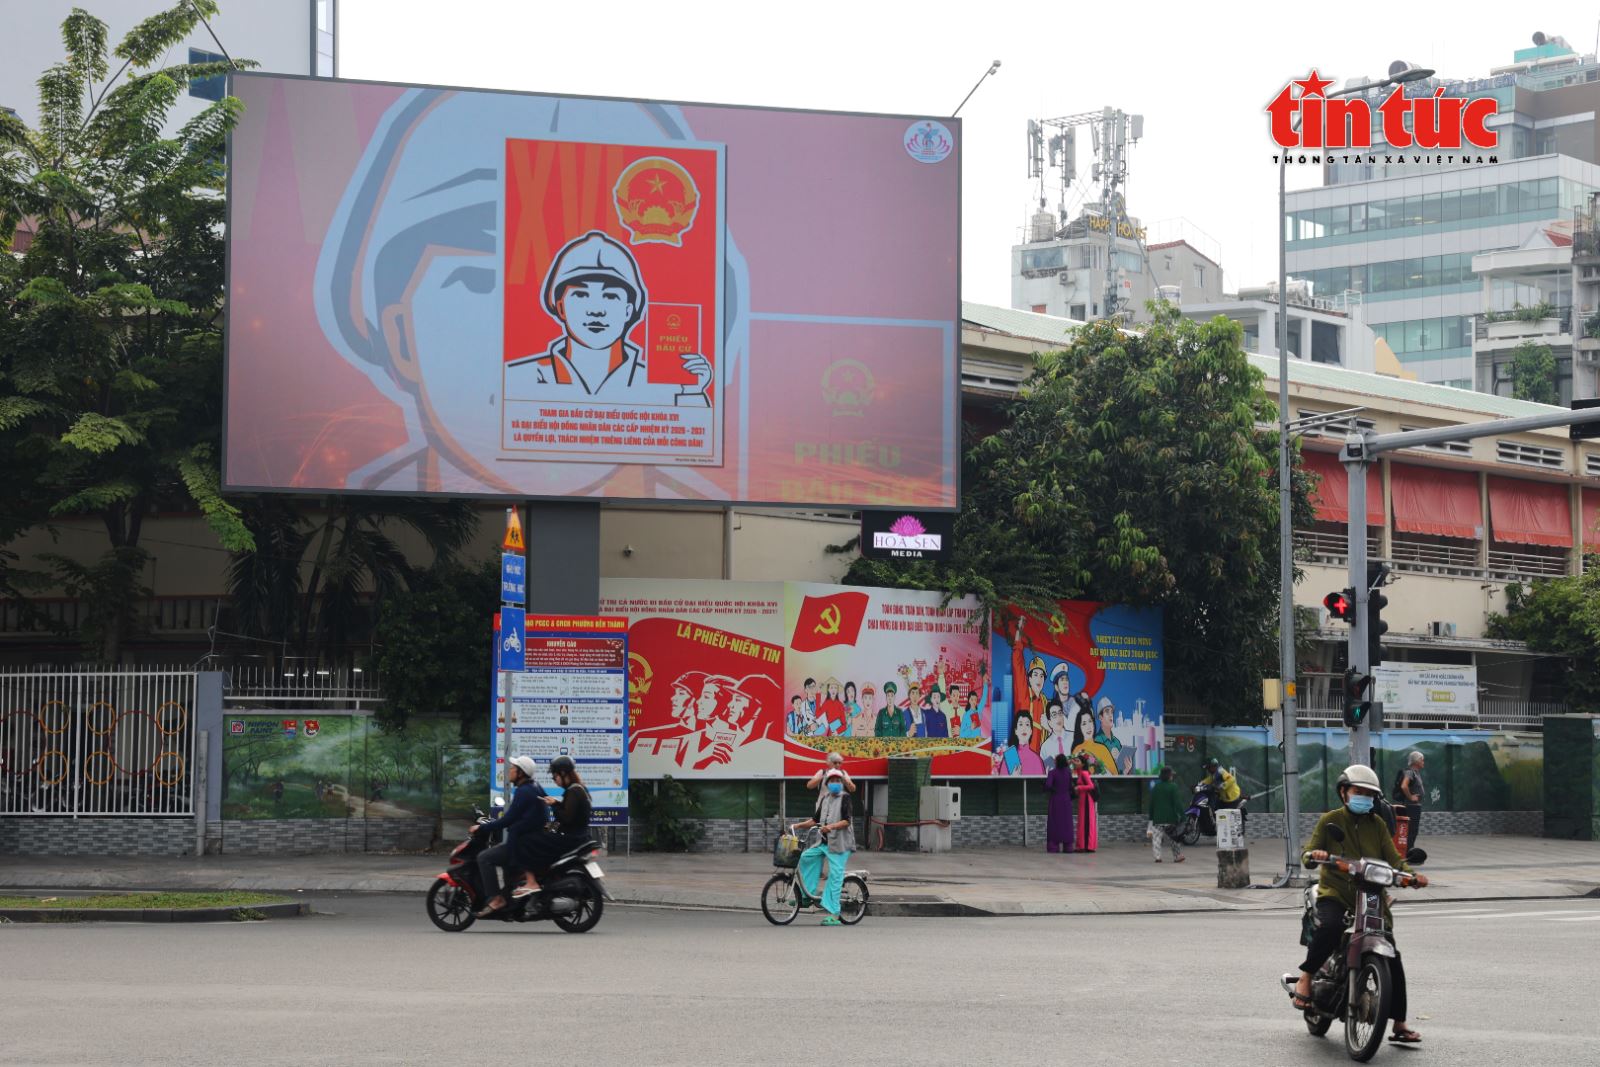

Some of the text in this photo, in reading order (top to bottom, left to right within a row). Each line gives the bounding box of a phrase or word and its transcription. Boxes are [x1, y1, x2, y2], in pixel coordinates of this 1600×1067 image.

[540, 408, 558, 417] THAM
[559, 410, 569, 418] GIA
[622, 410, 638, 420] QUỐC
[640, 411, 650, 422] HỘI
[612, 423, 624, 432] CÁC
[876, 535, 940, 549] HOA SEN
[676, 622, 692, 639] LÁ
[762, 646, 781, 664] TIN
